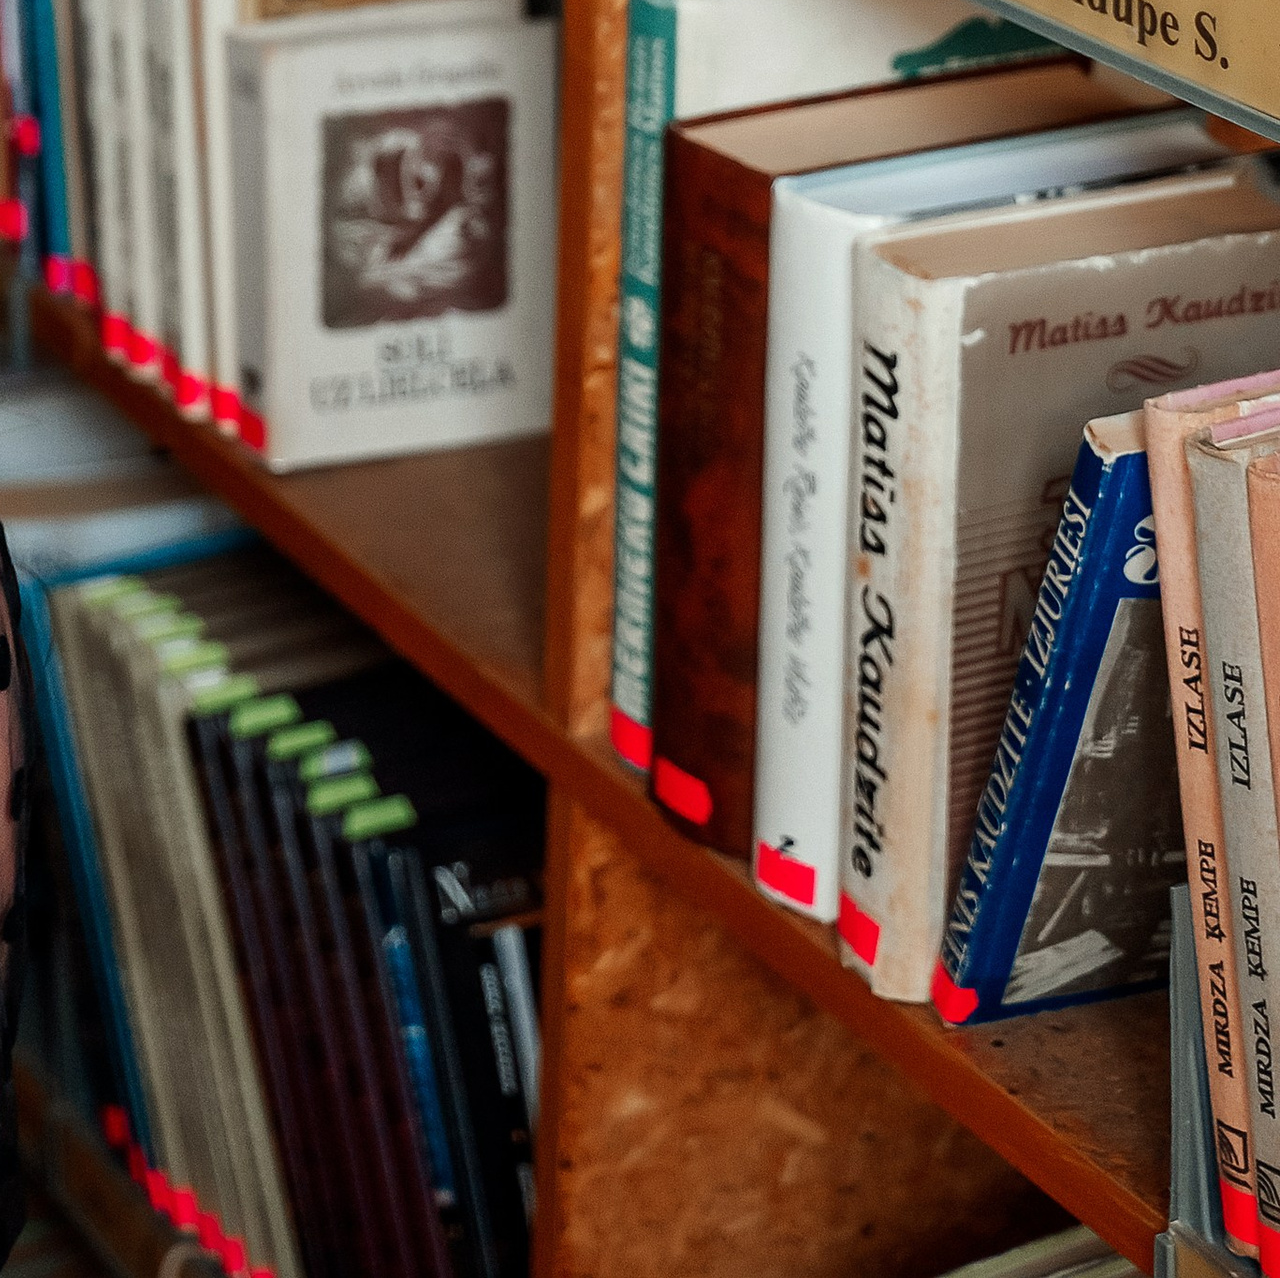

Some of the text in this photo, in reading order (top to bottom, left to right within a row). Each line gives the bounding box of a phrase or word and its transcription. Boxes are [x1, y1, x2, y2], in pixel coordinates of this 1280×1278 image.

[1194, 11, 1230, 70] S.
[1179, 626, 1235, 1079] MIRDZA ĶEMPE IZLASE
[1222, 660, 1276, 1120] MIRDZA ĶEMPE IZLASE
